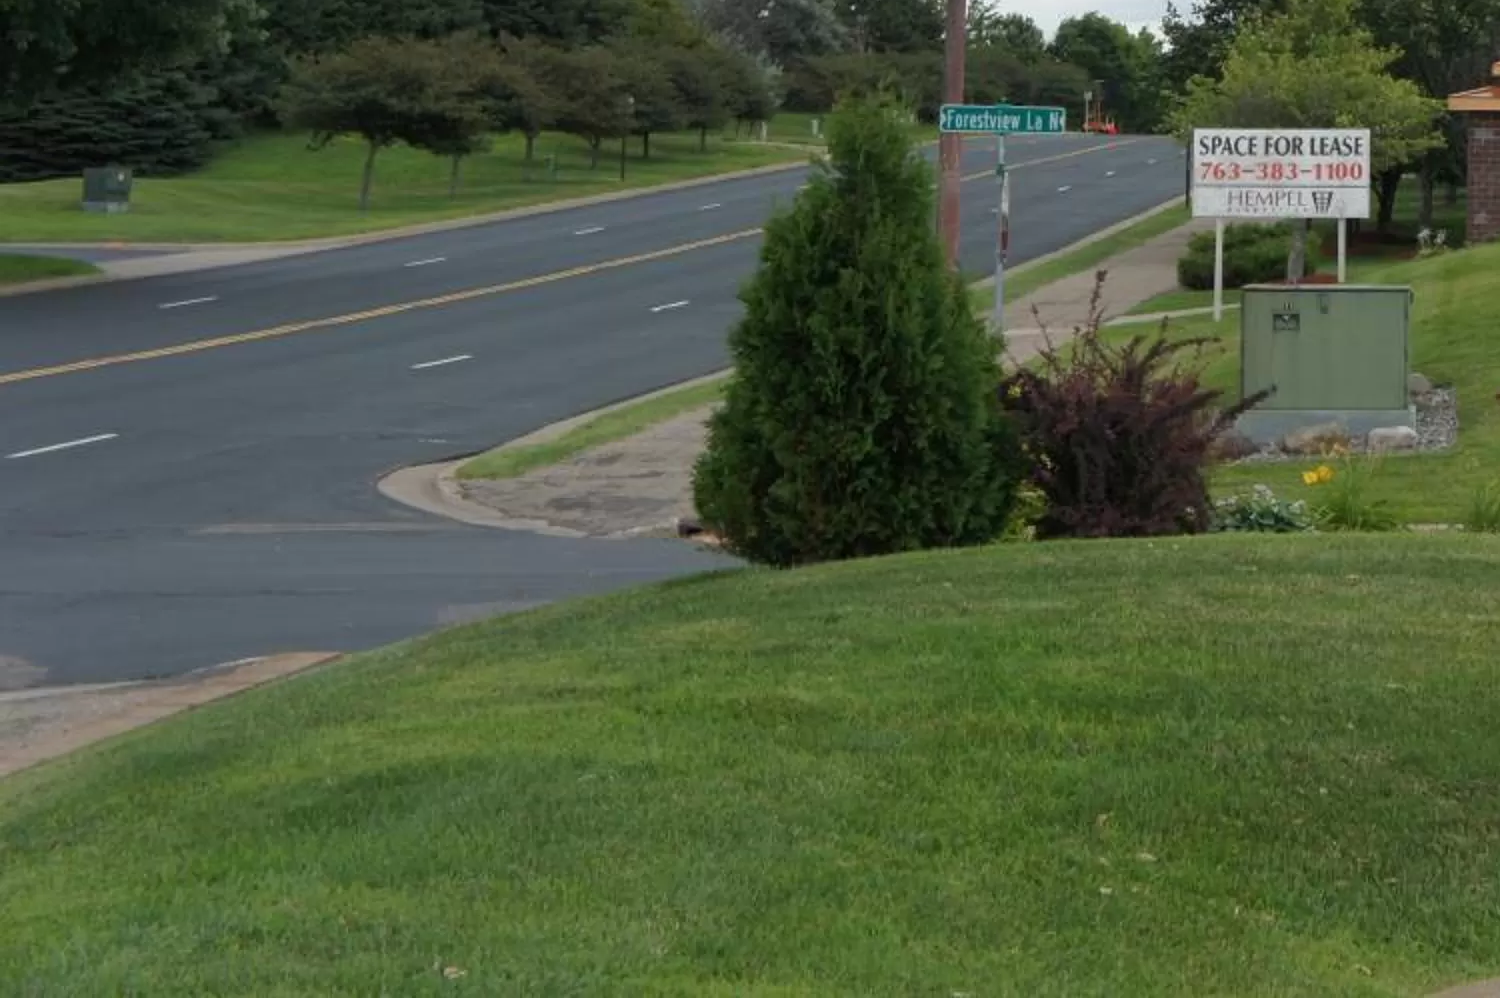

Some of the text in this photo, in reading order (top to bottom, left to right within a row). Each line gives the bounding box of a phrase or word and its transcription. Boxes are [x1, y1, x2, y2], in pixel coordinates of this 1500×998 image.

[946, 109, 1060, 131] Forestview La N
[1199, 135, 1363, 157] SPACE FOR LEASE
[1200, 162, 1363, 180] 763-383-1100
[1227, 189, 1307, 207] HEMPEL
